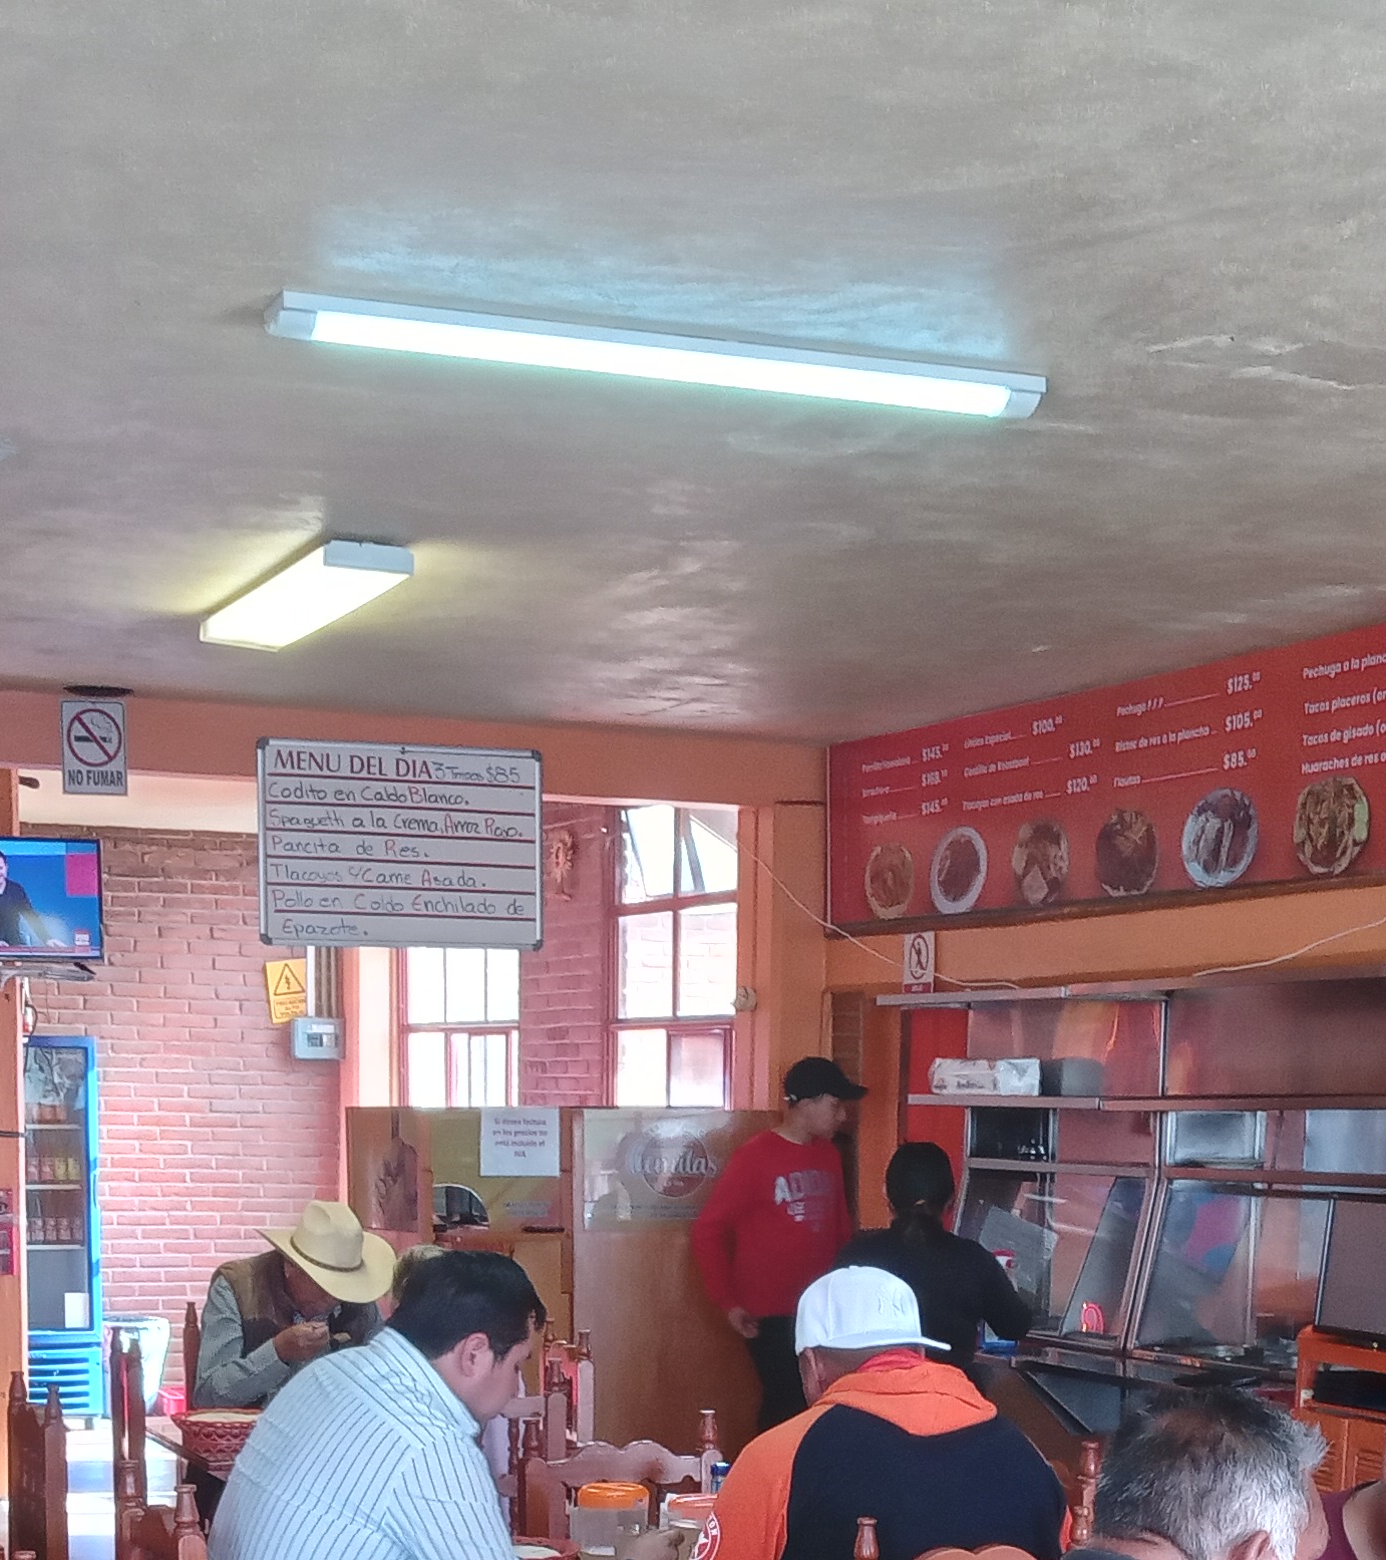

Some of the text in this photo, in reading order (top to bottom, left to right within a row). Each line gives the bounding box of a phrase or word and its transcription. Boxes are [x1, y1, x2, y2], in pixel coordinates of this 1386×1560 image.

[1302, 661, 1341, 680] Pechuga
[1343, 661, 1350, 671] a
[1351, 657, 1360, 669] la
[1304, 699, 1330, 715] Tacos
[1331, 692, 1371, 713] placeros
[274, 749, 521, 783] MENU DEL DIA $85
[1301, 755, 1350, 774] Huaraches
[1351, 755, 1363, 766] de
[1364, 752, 1379, 764] res
[67, 769, 124, 787] NO FUMAR
[268, 780, 328, 801] Codito
[333, 788, 356, 802] en
[408, 785, 470, 806] Blanco.
[352, 816, 366, 828] a
[370, 810, 388, 829] la
[444, 813, 481, 835] Arroz
[272, 836, 430, 859] Pancita de Res.
[270, 862, 343, 883] Tlacoyos
[271, 888, 313, 909] Pollo
[319, 895, 341, 908] en
[412, 893, 497, 915] Enchilado
[506, 900, 525, 916] de
[282, 917, 369, 939] Epazote.
